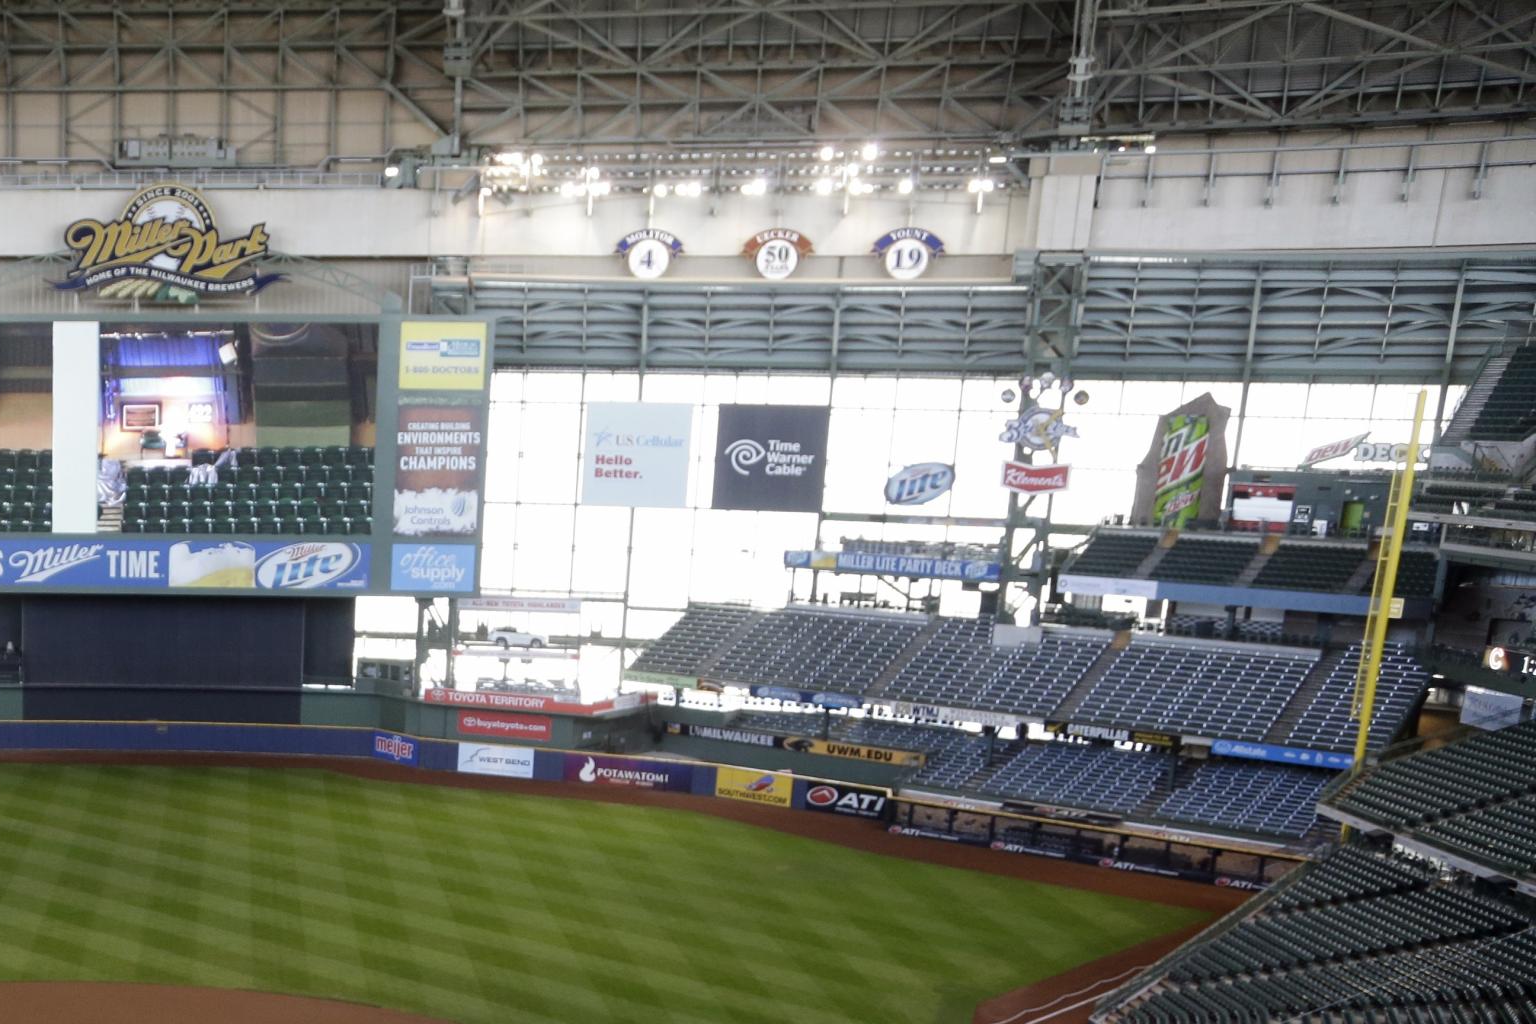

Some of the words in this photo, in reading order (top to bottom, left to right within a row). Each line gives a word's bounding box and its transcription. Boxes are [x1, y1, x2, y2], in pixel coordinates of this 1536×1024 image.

[135, 188, 172, 206] SINCE
[174, 187, 200, 206] 2001
[626, 230, 674, 246] MOLITOR
[889, 230, 928, 241] YOUNT
[66, 218, 192, 275] Miller
[167, 222, 269, 279] Park
[639, 249, 653, 270] 4
[765, 246, 788, 263] 50
[893, 248, 922, 269] 19
[85, 270, 112, 286] HOME
[114, 267, 128, 277] OF
[130, 266, 148, 277] THE
[151, 270, 206, 290] MILWAUKEE
[207, 278, 254, 292] BREWERS
[408, 422, 439, 431] CREATING
[440, 422, 471, 431] BUILDING
[397, 432, 481, 445] ENVIRONMENTS
[636, 434, 685, 447] Cellular
[768, 440, 801, 452] Time
[416, 447, 433, 455] THAT
[434, 447, 462, 455] INSPIRE
[766, 453, 815, 464] Warner
[400, 456, 476, 471] CHAMPIONS
[595, 455, 633, 466] Hello
[594, 467, 643, 479] Better.
[765, 464, 803, 476] Cable
[404, 505, 444, 515] Johnson
[411, 516, 451, 526] Controls
[9, 543, 104, 583] Miller
[400, 546, 456, 574] office
[838, 553, 875, 569] MILLER
[876, 556, 897, 572] LITE
[899, 557, 932, 574] PARTY
[934, 561, 962, 576] DECK
[411, 565, 464, 582] supply
[448, 691, 486, 705] TOYOTA
[489, 694, 545, 709] TERRITORY
[913, 704, 940, 718] WTMJ
[1067, 723, 1128, 741] CATERPILLAR
[376, 735, 413, 760] meijer
[826, 743, 893, 761] UWM.EDU
[505, 758, 531, 766] BEND
[597, 767, 669, 783] POTAWATOMI
[718, 787, 787, 804] SOUTHWEST.COM
[838, 792, 885, 812] ATI
[902, 828, 919, 836] ATI
[1004, 843, 1023, 852] ATI
[1114, 861, 1135, 870] ATI
[1229, 879, 1252, 889] ATI
